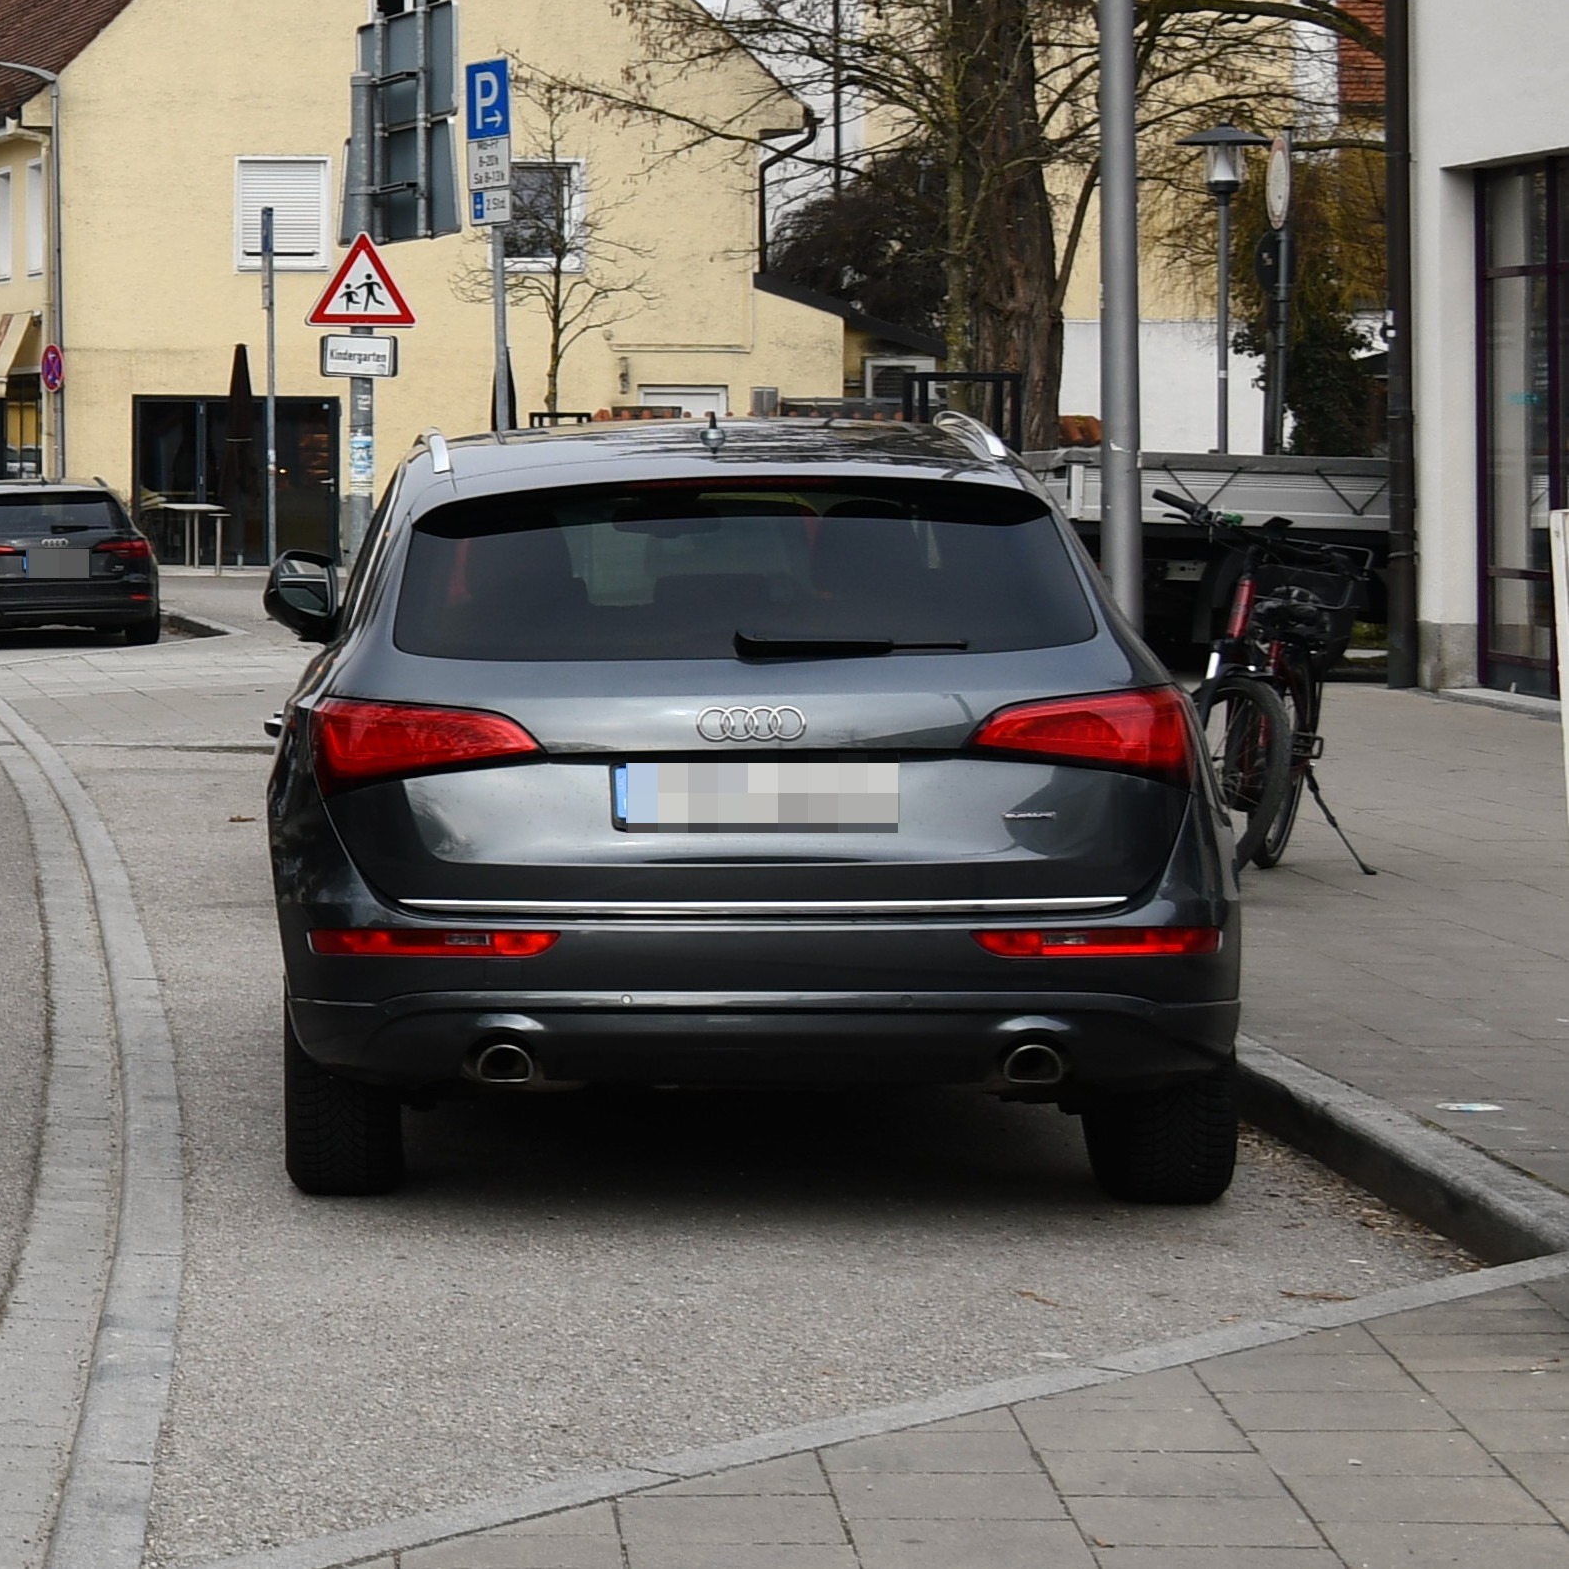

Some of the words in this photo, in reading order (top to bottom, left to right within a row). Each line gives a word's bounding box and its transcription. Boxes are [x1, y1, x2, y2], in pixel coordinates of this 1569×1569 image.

[475, 71, 499, 129] P
[473, 173, 483, 185] Sa
[330, 349, 386, 364] Kindergarten
